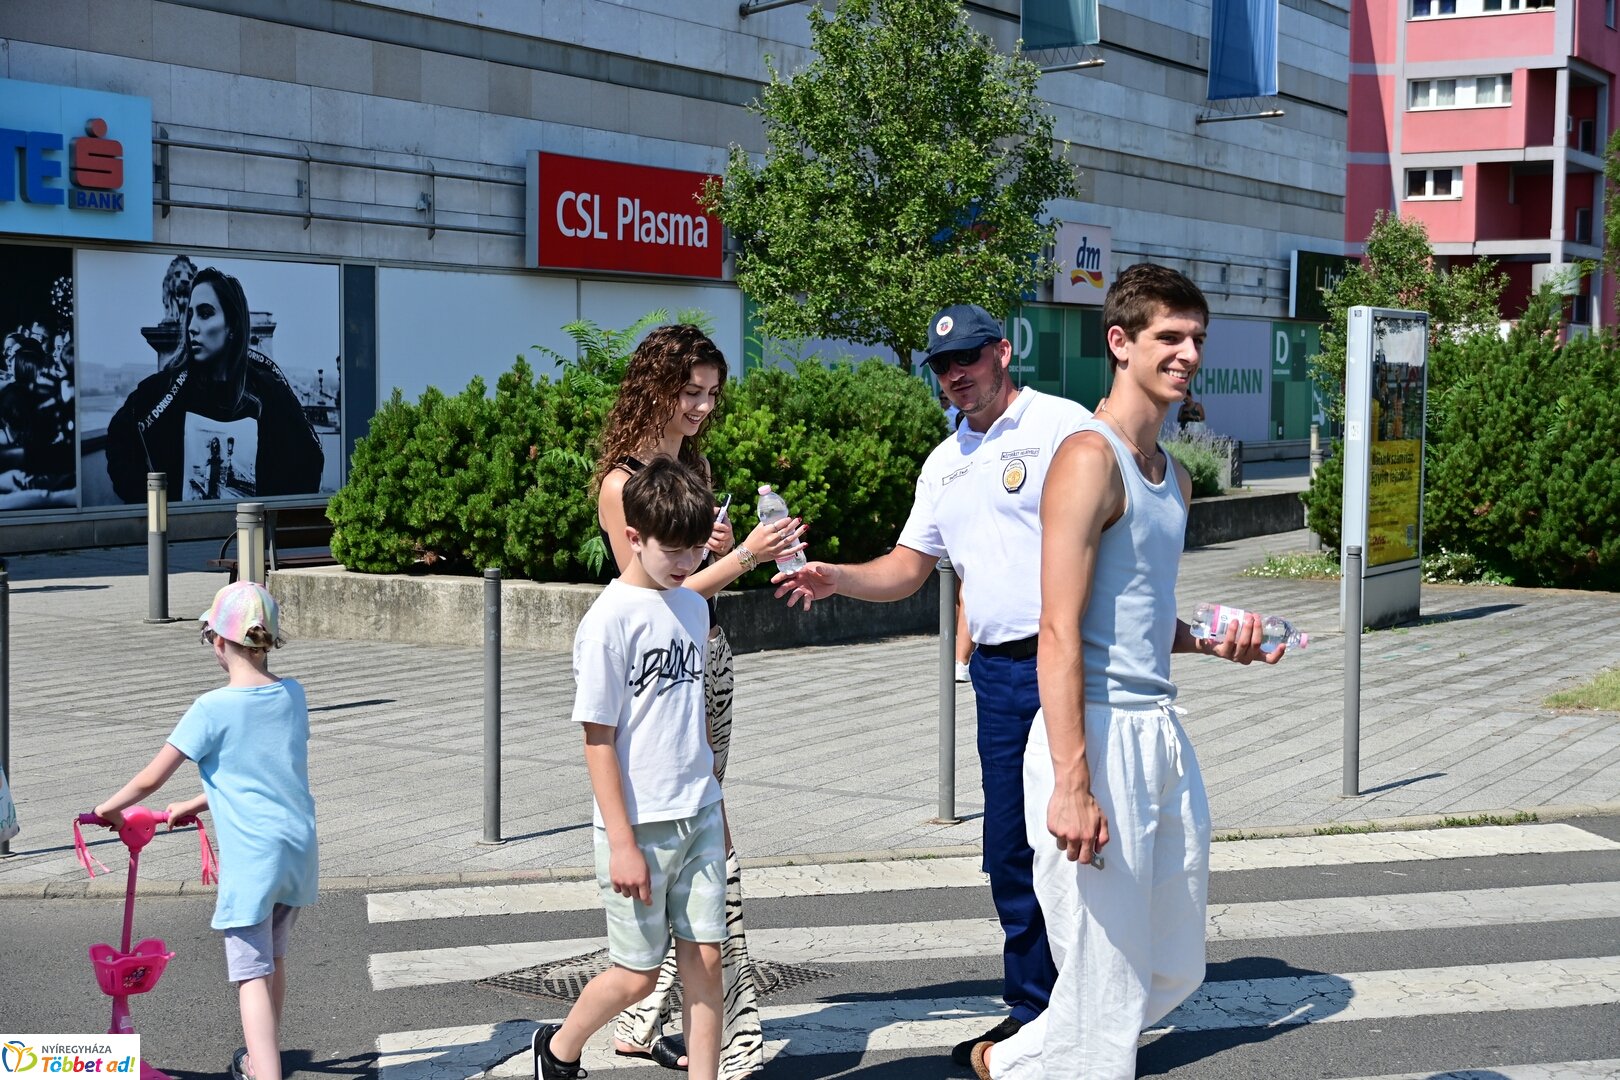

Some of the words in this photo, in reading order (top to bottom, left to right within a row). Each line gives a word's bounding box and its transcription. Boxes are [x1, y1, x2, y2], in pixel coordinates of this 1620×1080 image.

[77, 192, 124, 211] BANK
[556, 190, 608, 240] CSL
[617, 196, 708, 248] Plasma
[1076, 236, 1100, 270] dm
[1013, 317, 1033, 359] D
[1276, 331, 1289, 365] D
[152, 394, 173, 418] DORKO
